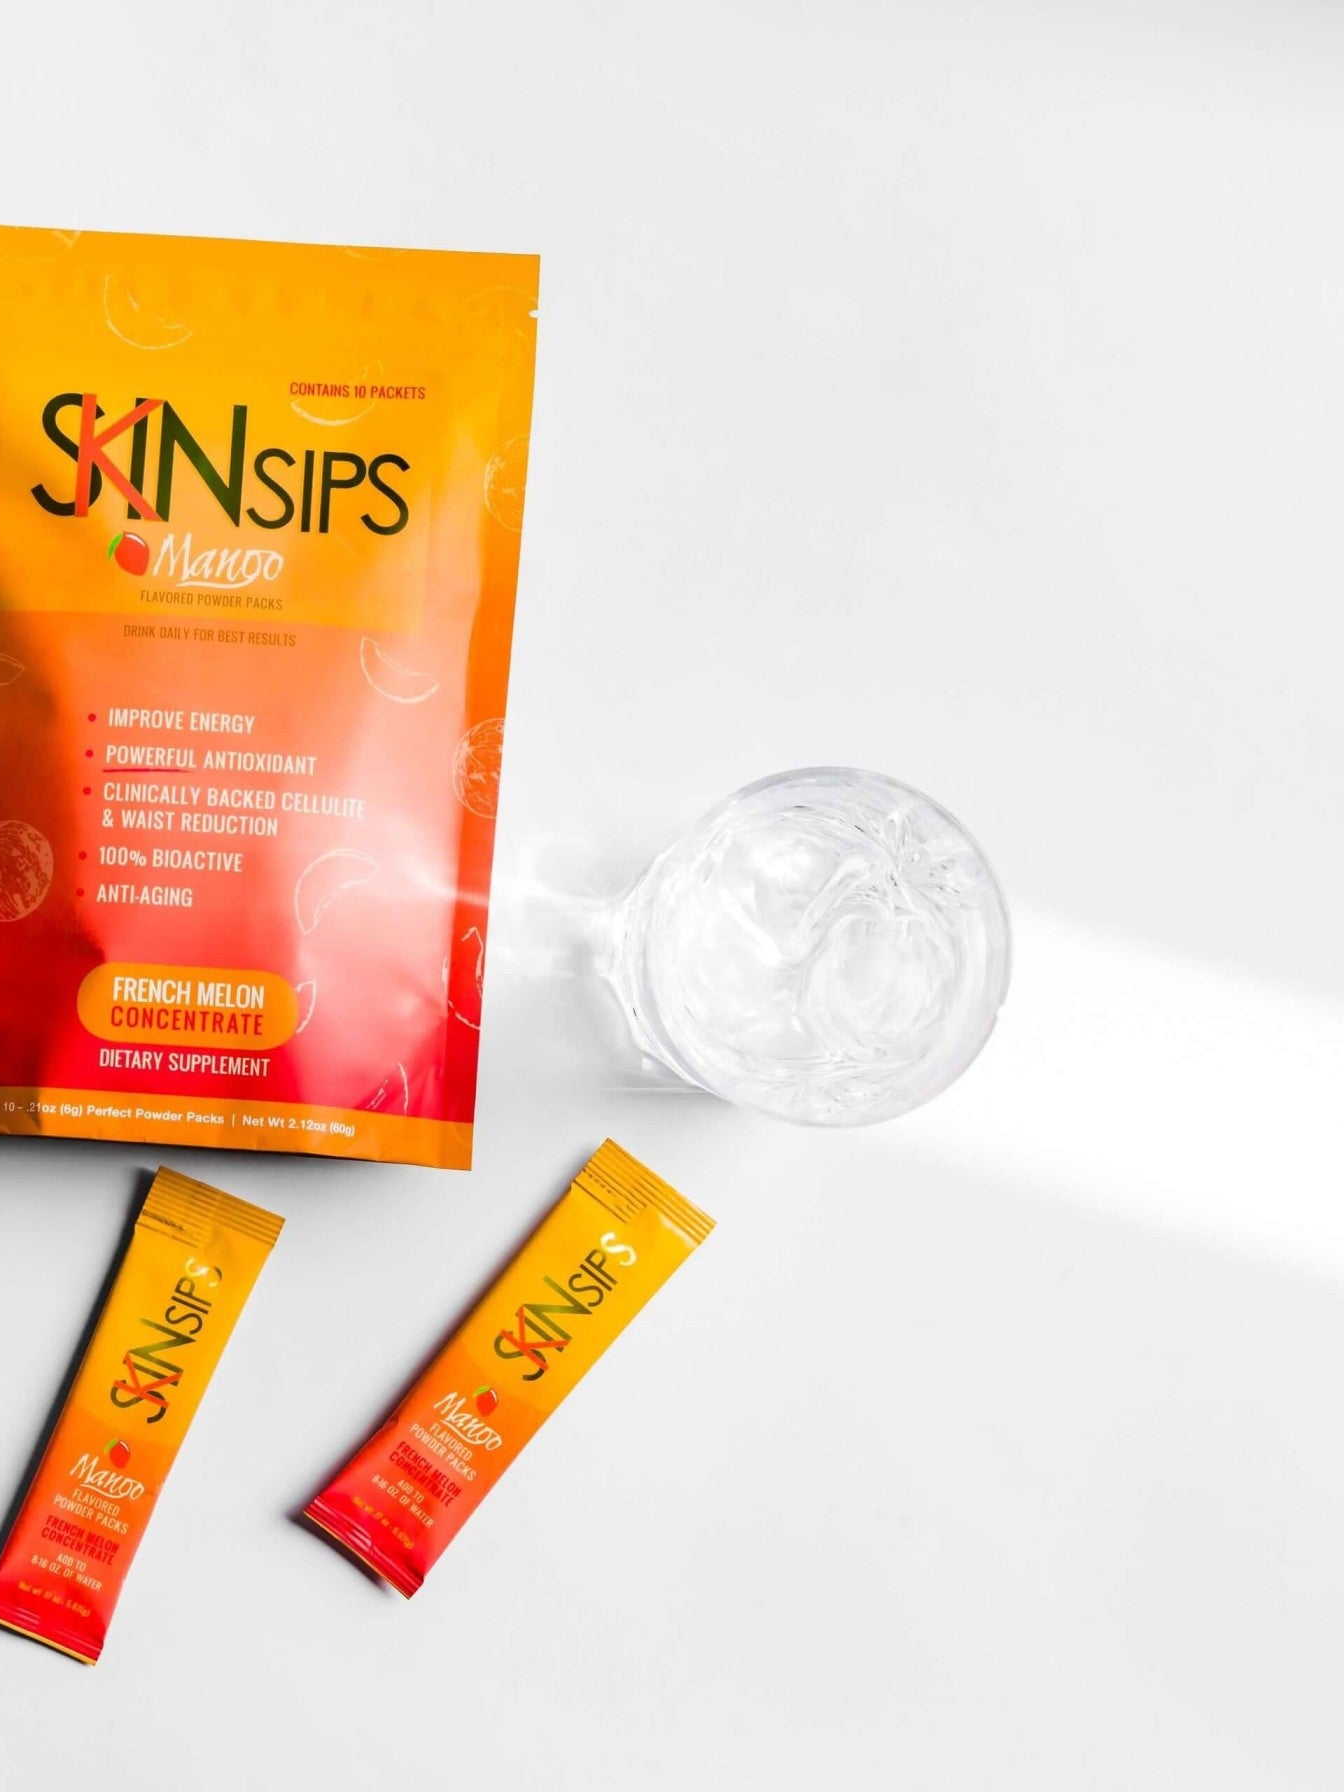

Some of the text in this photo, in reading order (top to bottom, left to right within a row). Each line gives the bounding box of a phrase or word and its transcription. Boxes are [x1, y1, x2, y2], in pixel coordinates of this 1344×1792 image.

[290, 382, 426, 399] CONTAINS 10 PACKETS
[153, 532, 284, 590] Mango
[140, 590, 283, 610] FLAVORED POWDER PACKS
[124, 625, 296, 647] DRINK DAILY FOR BEST RESULTS
[109, 708, 255, 734] IMPROVE ENERGY
[106, 744, 317, 776] POWERFUL ANTIOXIDANT
[103, 782, 366, 820] CLINICALLY BACKED CELLULITE
[102, 809, 278, 837] & WAIST REDUCTION
[99, 846, 243, 872] 100% BIOACTIVE
[96, 884, 193, 908] ANTI-AGING
[113, 976, 264, 1009] FRENCH MELON
[111, 1005, 263, 1036] CONCENTRATE
[99, 1048, 271, 1077] DIETARY SUPPLEMENT
[3, 1102, 15, 1112] 10
[26, 1103, 56, 1113] .21oz
[60, 1103, 83, 1117] (6g)
[87, 1105, 131, 1118] Perfect
[136, 1109, 183, 1121] Powder
[186, 1111, 224, 1124] Packs
[242, 1115, 264, 1127] Net
[268, 1117, 284, 1128] Wt
[288, 1118, 326, 1132] 2.12oz
[330, 1122, 356, 1137] (60g)
[433, 1392, 502, 1451] Mango
[410, 1423, 477, 1482] POWDER PACKS
[429, 1423, 473, 1461] FLAVORED
[69, 1453, 145, 1501] Mango
[389, 1451, 454, 1507] CONCENTRATE
[397, 1441, 462, 1498] FRENCH MELON
[72, 1489, 120, 1516] FLAVORED
[396, 1479, 425, 1503] ADD TO
[53, 1494, 129, 1535] POWDER PACKS
[399, 1495, 411, 1507] OF
[409, 1504, 434, 1528] WATER
[41, 1527, 113, 1566] CONCENTRATE
[46, 1515, 119, 1554] FRENCH MELON
[56, 1553, 87, 1572] ADD TO
[63, 1568, 74, 1578] OF
[76, 1572, 103, 1592] WATER
